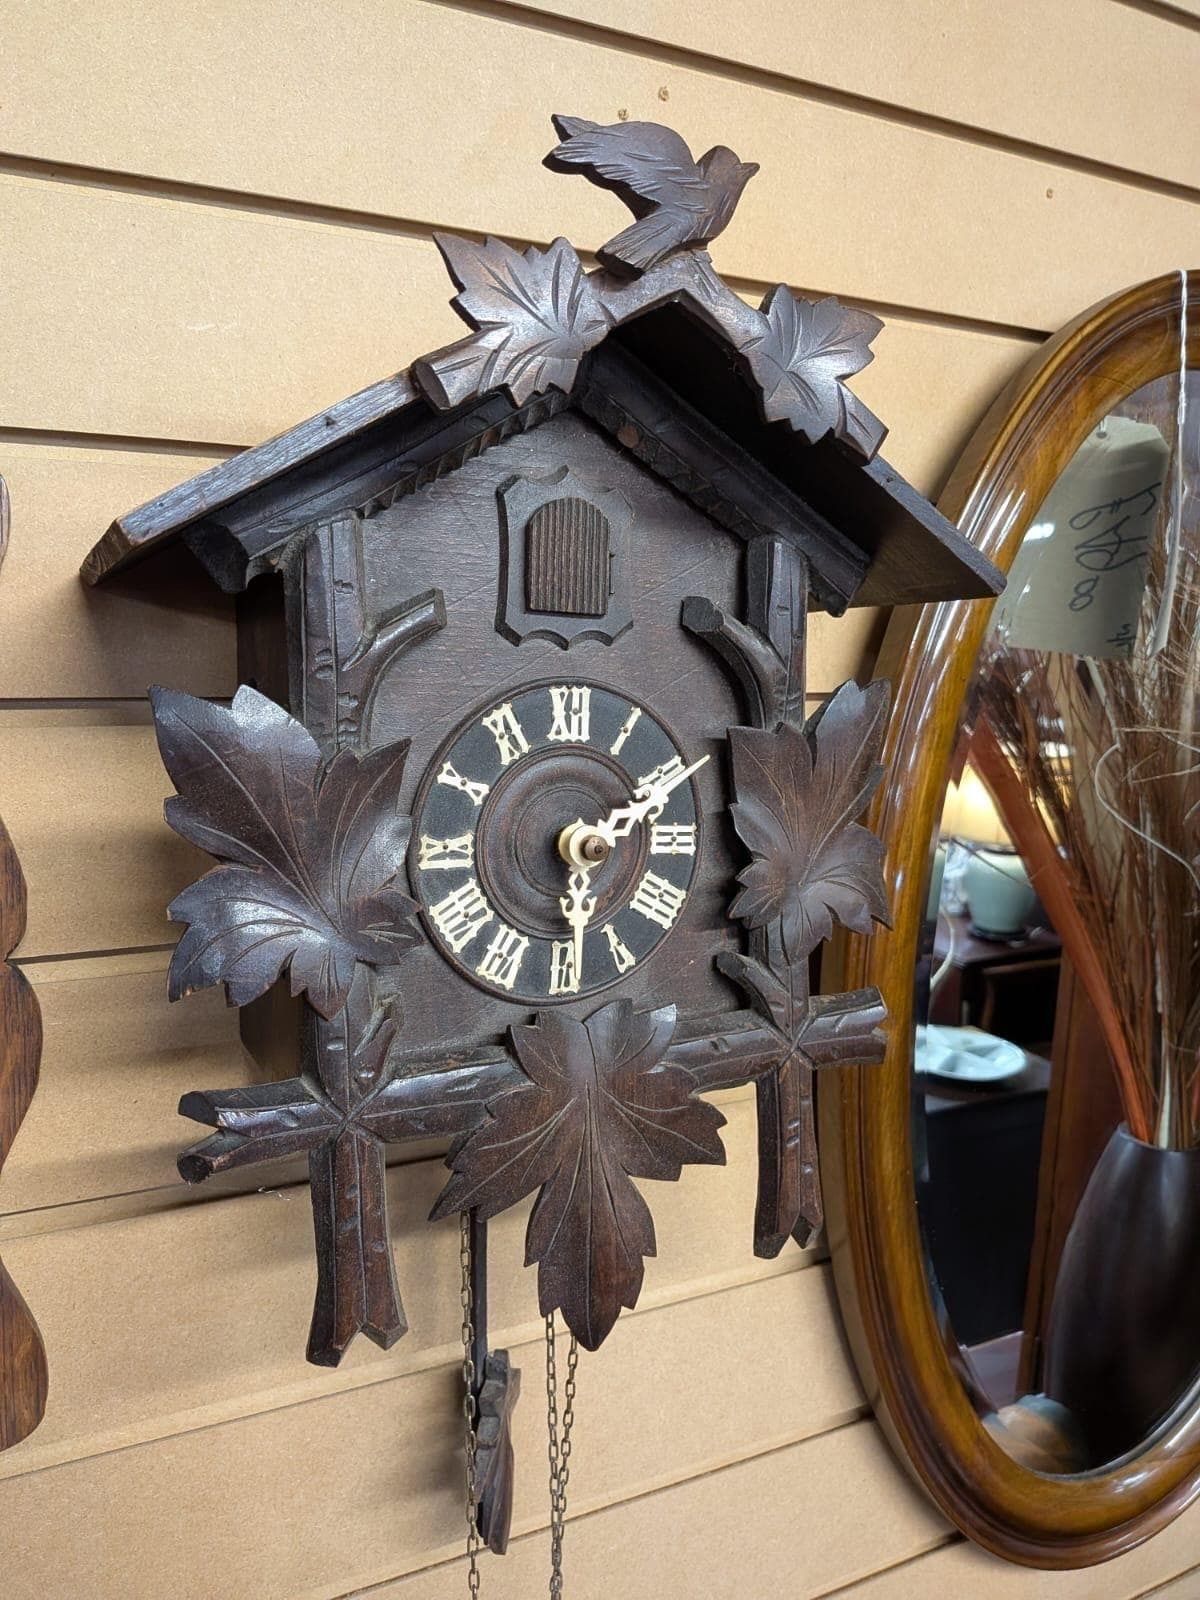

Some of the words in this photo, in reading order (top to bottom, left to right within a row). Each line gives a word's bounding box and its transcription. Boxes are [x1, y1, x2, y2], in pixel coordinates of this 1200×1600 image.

[482, 703, 530, 765] XI
[547, 686, 591, 742] XII
[610, 706, 641, 755] I
[437, 762, 490, 805] X
[420, 832, 474, 870] IX
[650, 822, 696, 856] III
[429, 878, 494, 953] VIII
[630, 870, 687, 929] IIII
[475, 924, 529, 990] VII
[601, 924, 636, 973] V
